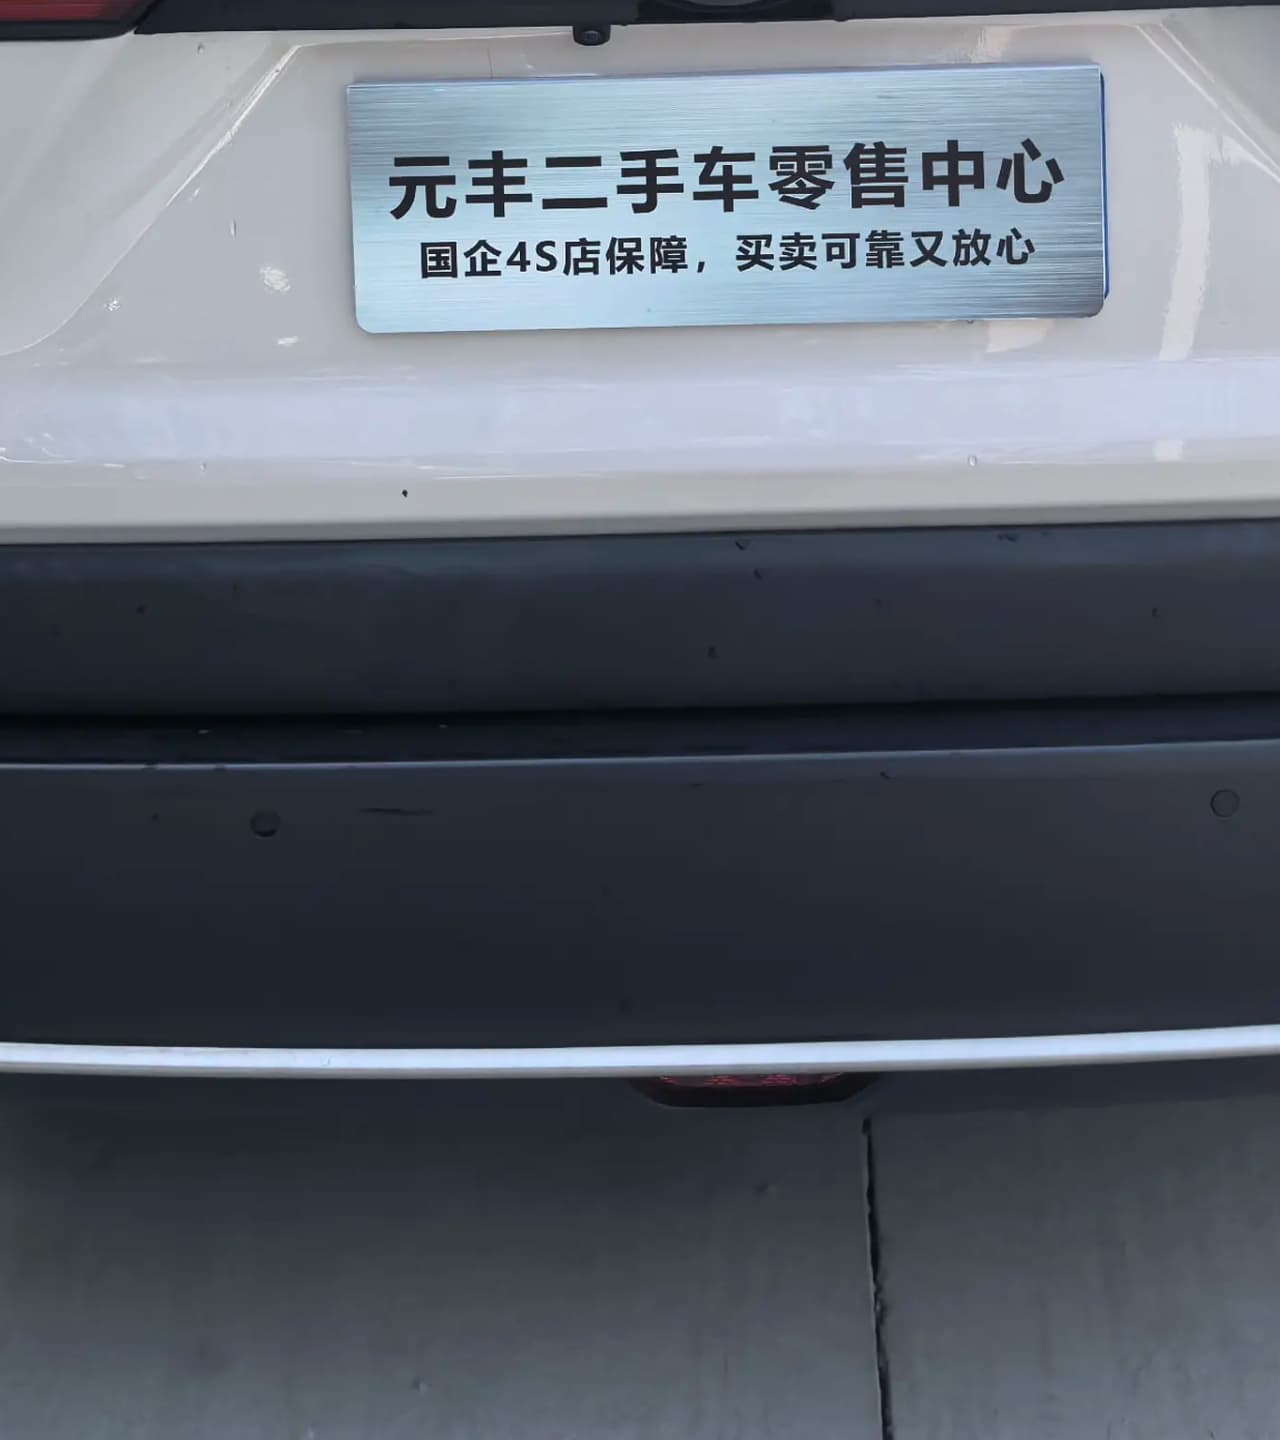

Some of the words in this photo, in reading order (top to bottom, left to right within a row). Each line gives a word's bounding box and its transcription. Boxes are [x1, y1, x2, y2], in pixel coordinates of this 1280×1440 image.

[389, 138, 1065, 220] 元丰二手车零售中心
[420, 227, 1036, 279] 国企4S店保障，买卖可靠又放心
